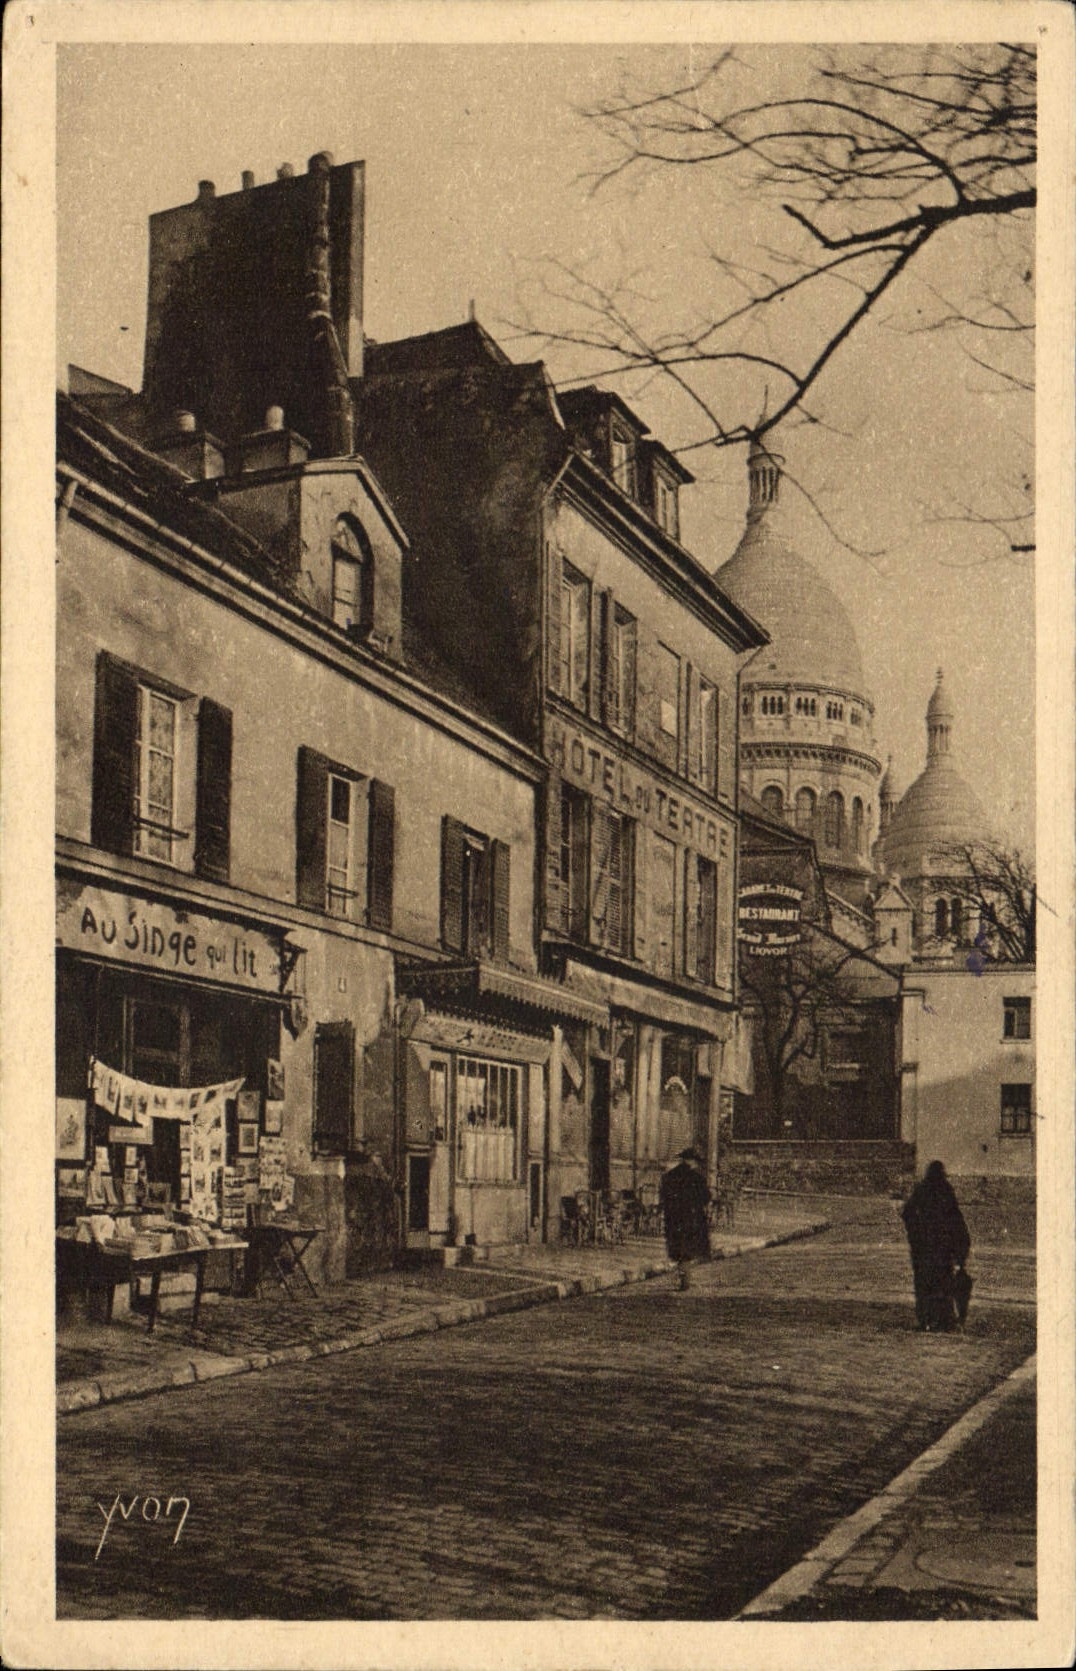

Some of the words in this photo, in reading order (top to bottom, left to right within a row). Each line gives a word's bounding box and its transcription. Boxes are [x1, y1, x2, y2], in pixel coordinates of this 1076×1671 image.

[656, 787, 729, 859] TERTRE
[124, 911, 197, 966] Singe
[206, 944, 227, 969] qui
[233, 937, 258, 978] lit
